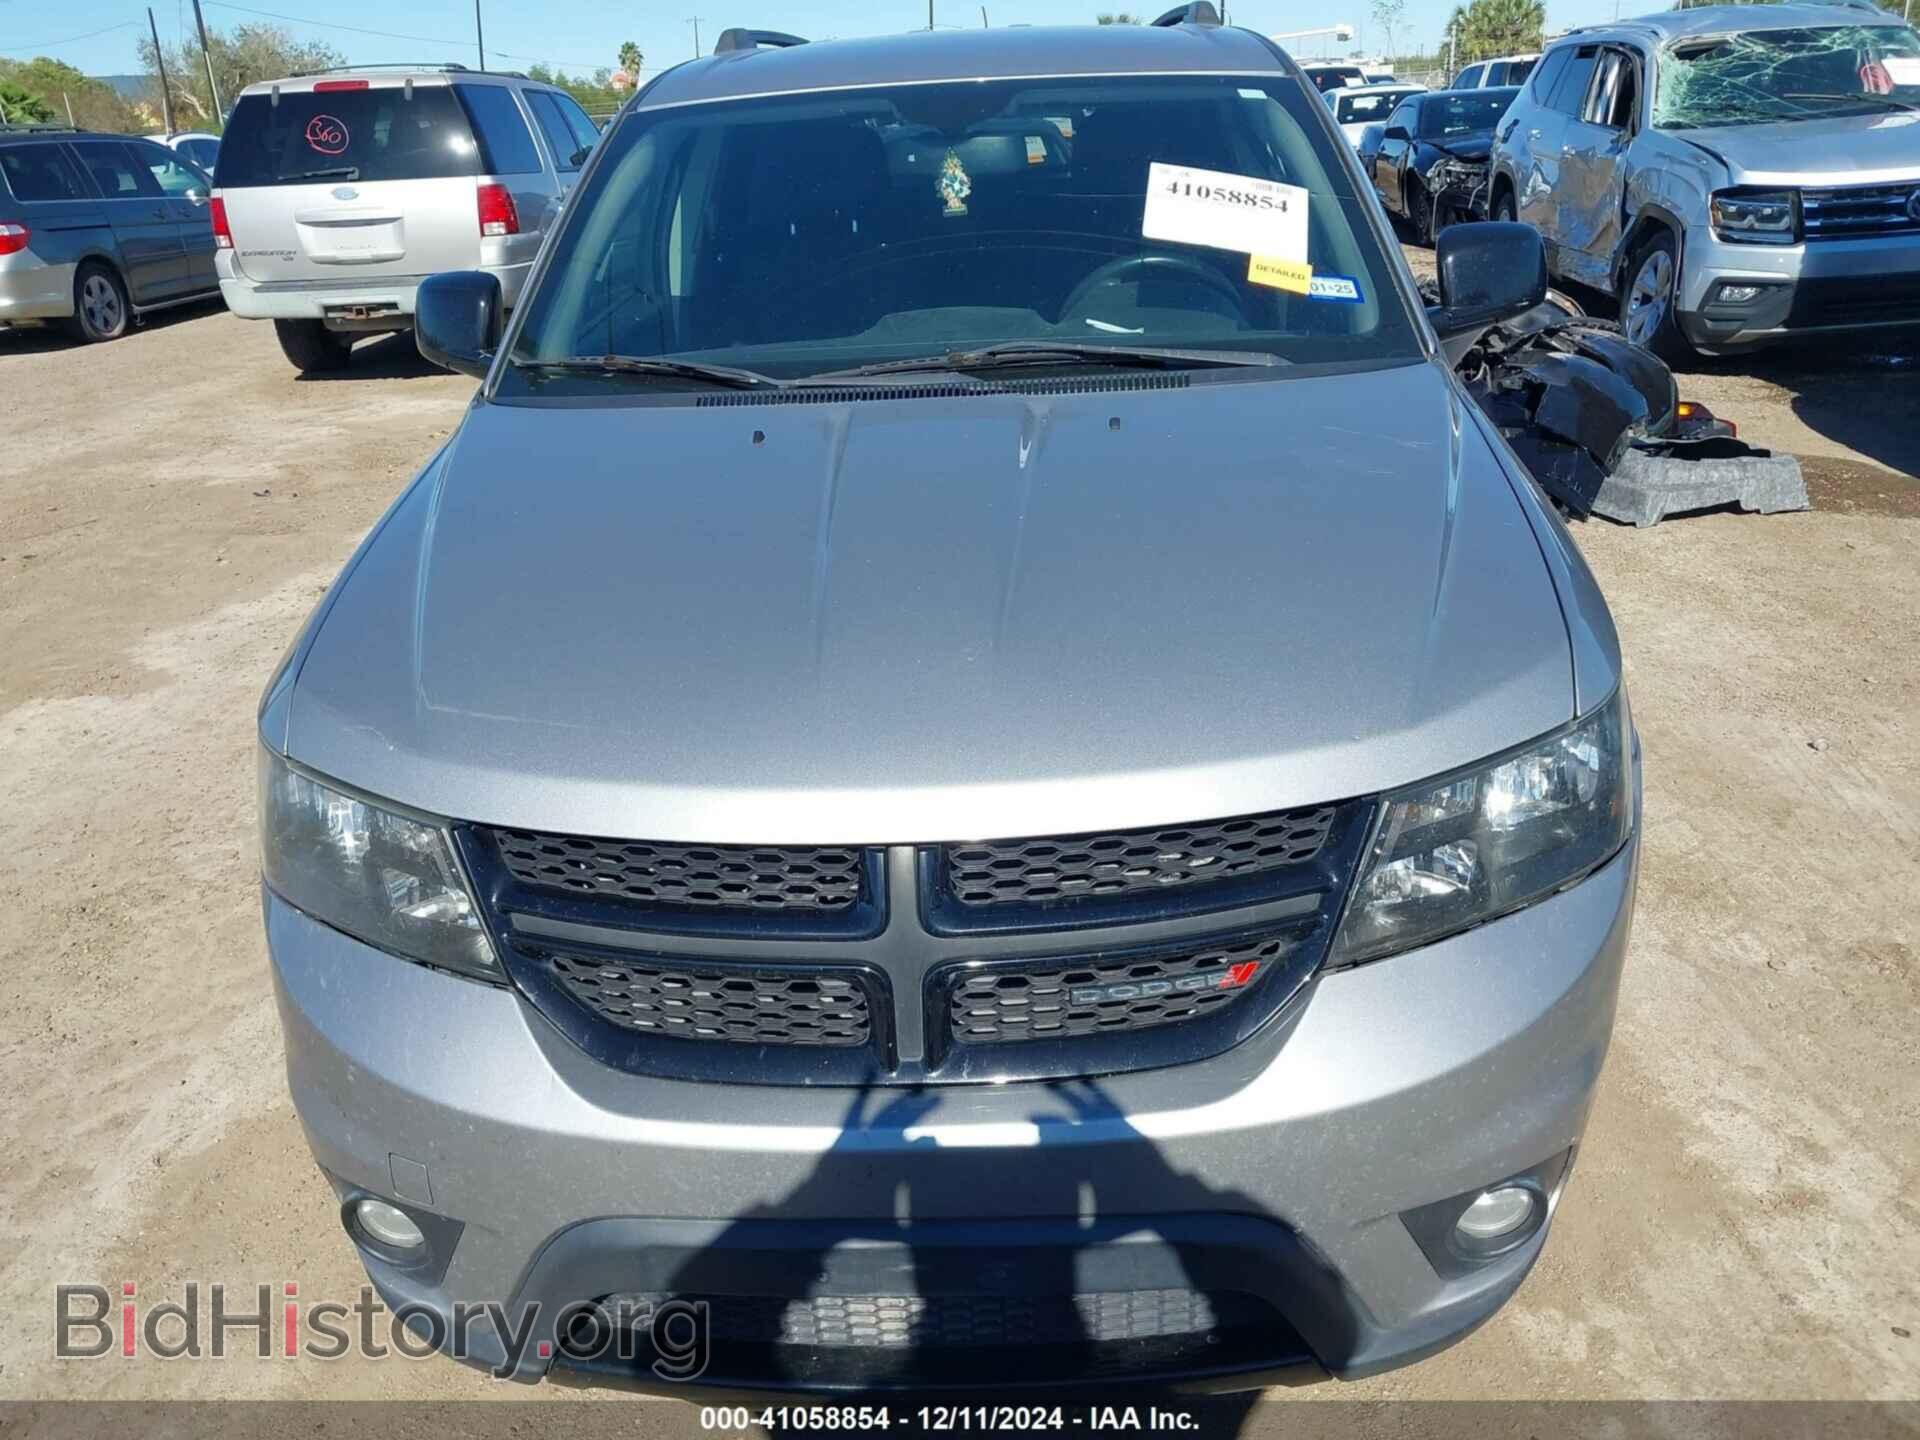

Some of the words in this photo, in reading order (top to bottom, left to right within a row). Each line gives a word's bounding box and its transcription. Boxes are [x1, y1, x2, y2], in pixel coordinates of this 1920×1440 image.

[1166, 181, 1288, 213] 41058854
[1255, 263, 1306, 281] DETAILED
[1071, 970, 1227, 1006] DODGE
